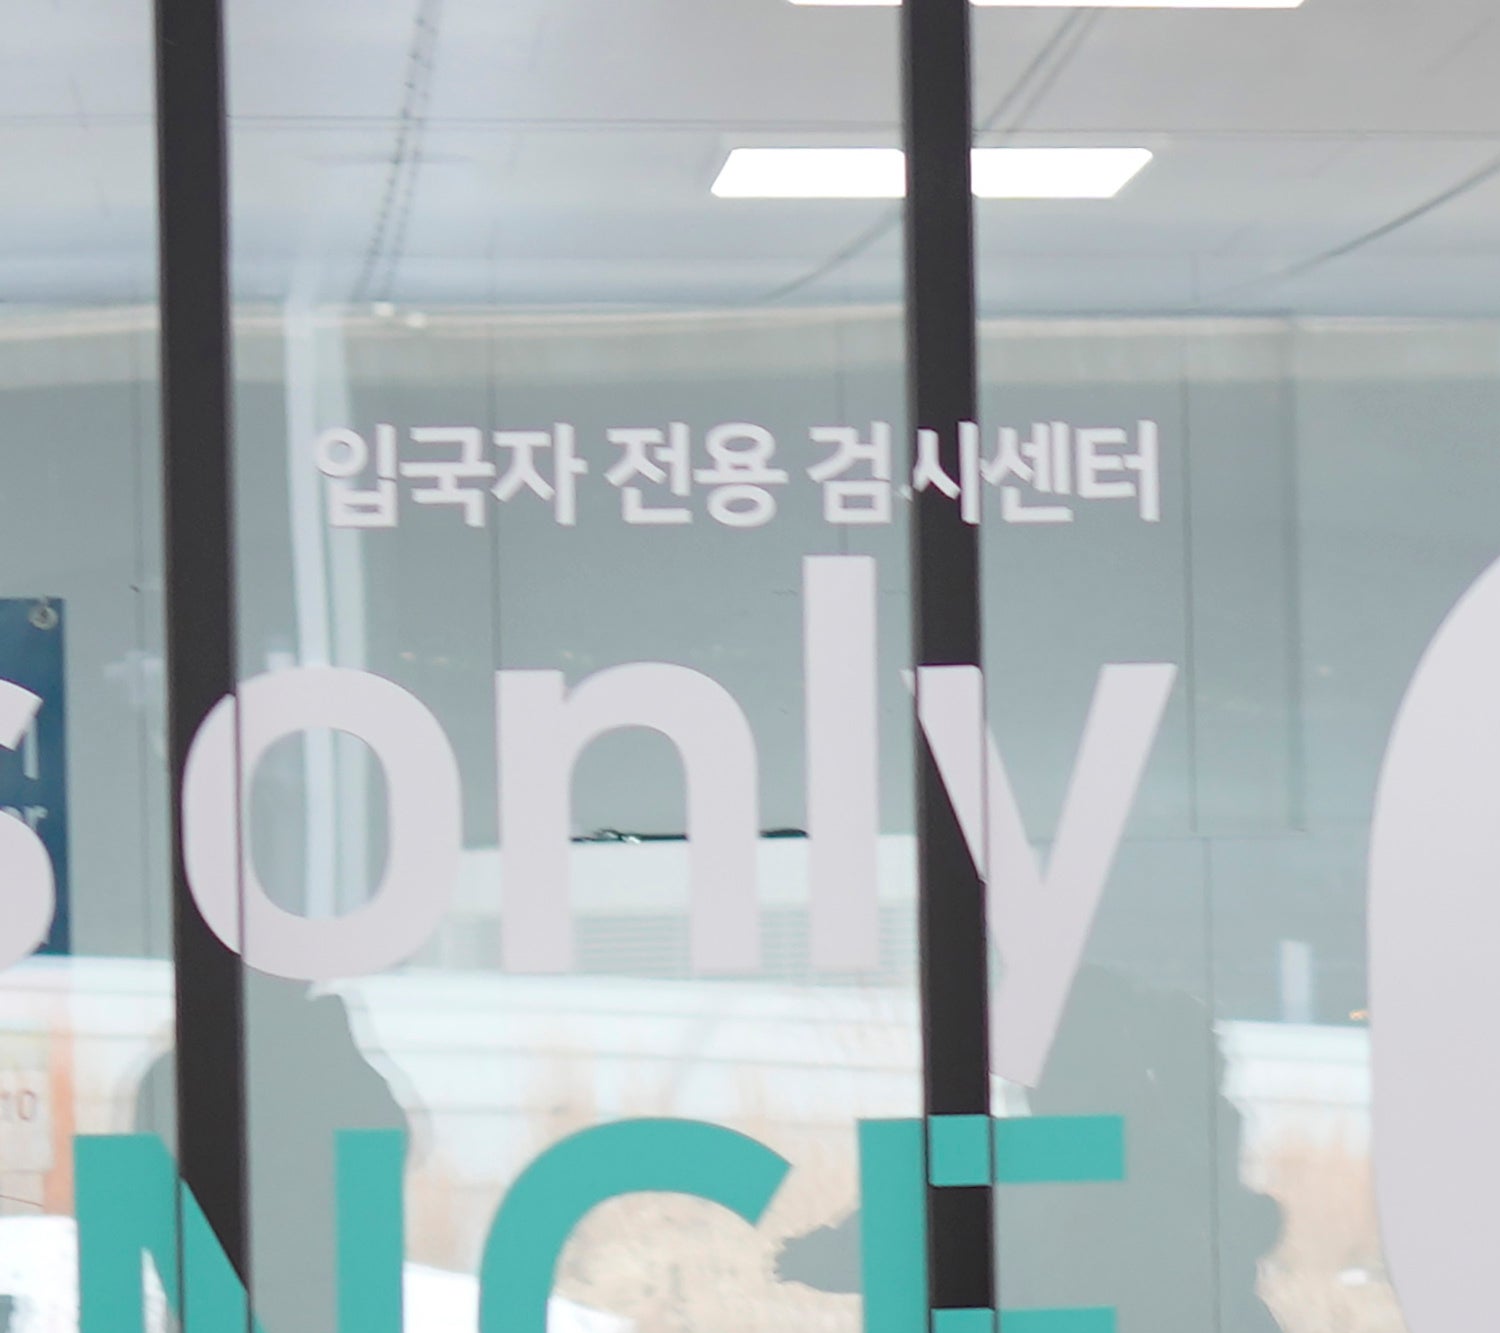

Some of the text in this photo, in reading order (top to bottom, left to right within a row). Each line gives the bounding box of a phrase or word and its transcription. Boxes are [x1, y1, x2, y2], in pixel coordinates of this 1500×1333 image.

[315, 419, 1161, 528] 입국자 전용 검사센터
[183, 555, 1177, 1087] only
